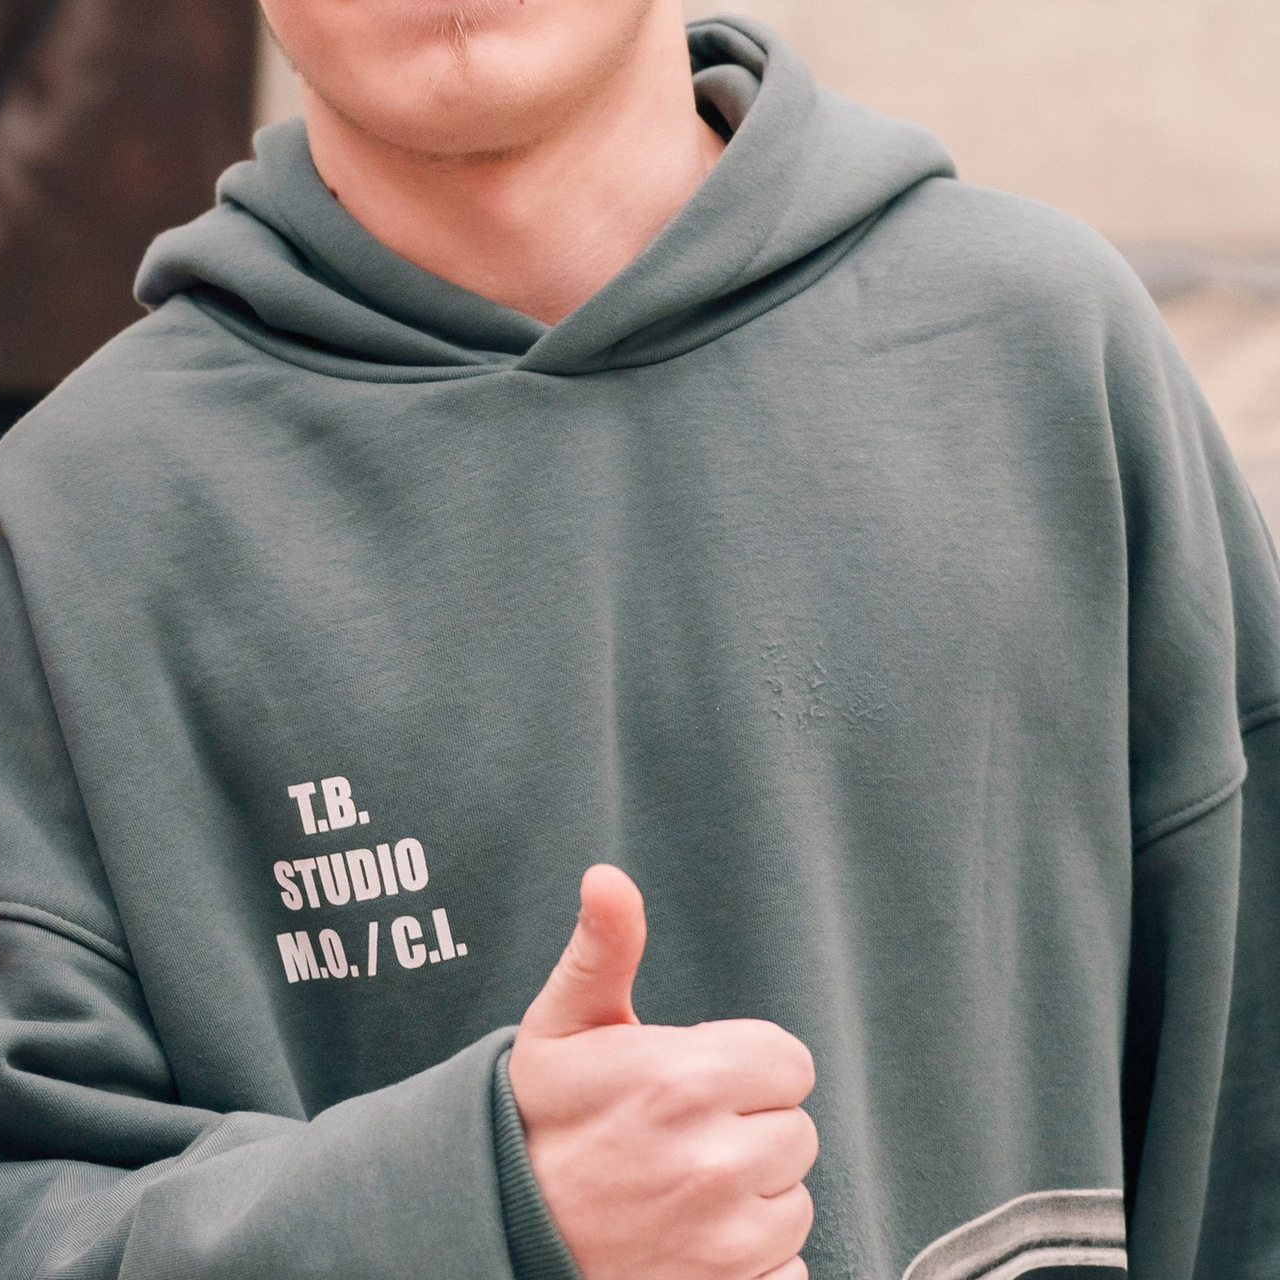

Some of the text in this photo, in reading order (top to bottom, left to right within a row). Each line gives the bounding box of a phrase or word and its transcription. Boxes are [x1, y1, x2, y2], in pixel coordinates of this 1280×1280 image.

[287, 775, 370, 836] T.B.
[273, 837, 429, 911] STUDIO
[276, 928, 360, 984] M.O.
[391, 907, 468, 970] C.I.
